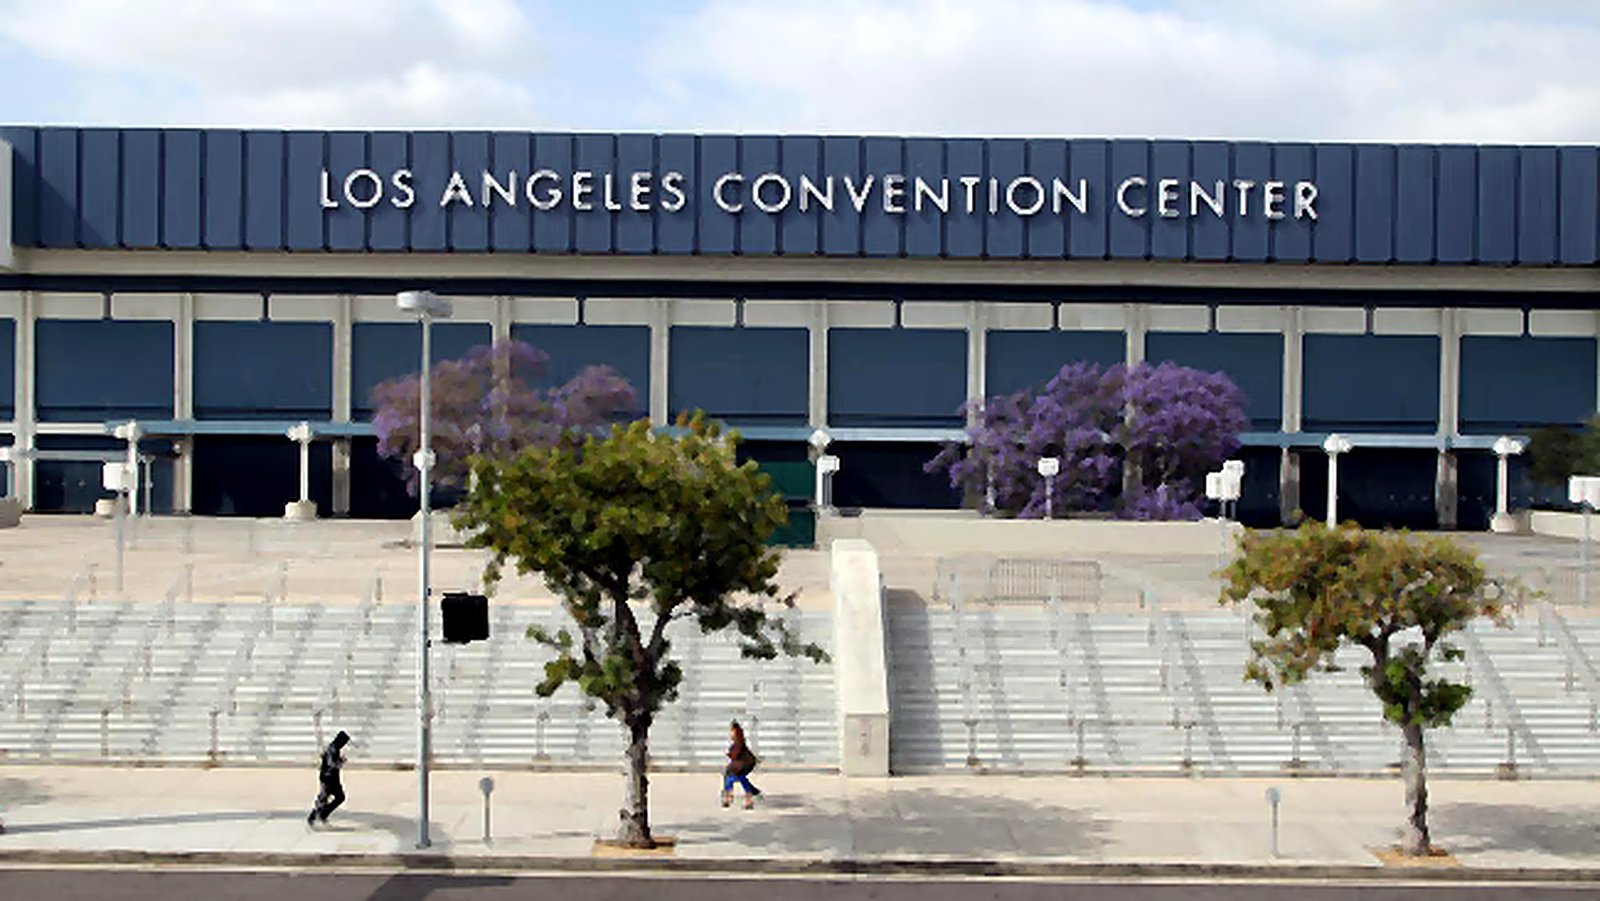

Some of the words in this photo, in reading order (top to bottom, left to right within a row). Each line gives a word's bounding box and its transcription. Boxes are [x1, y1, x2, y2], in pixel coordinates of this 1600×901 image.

[319, 167, 416, 210] LOS
[439, 168, 686, 212] ANGELES
[712, 172, 1088, 216] CONVENTION
[1115, 175, 1320, 221] CENTER
